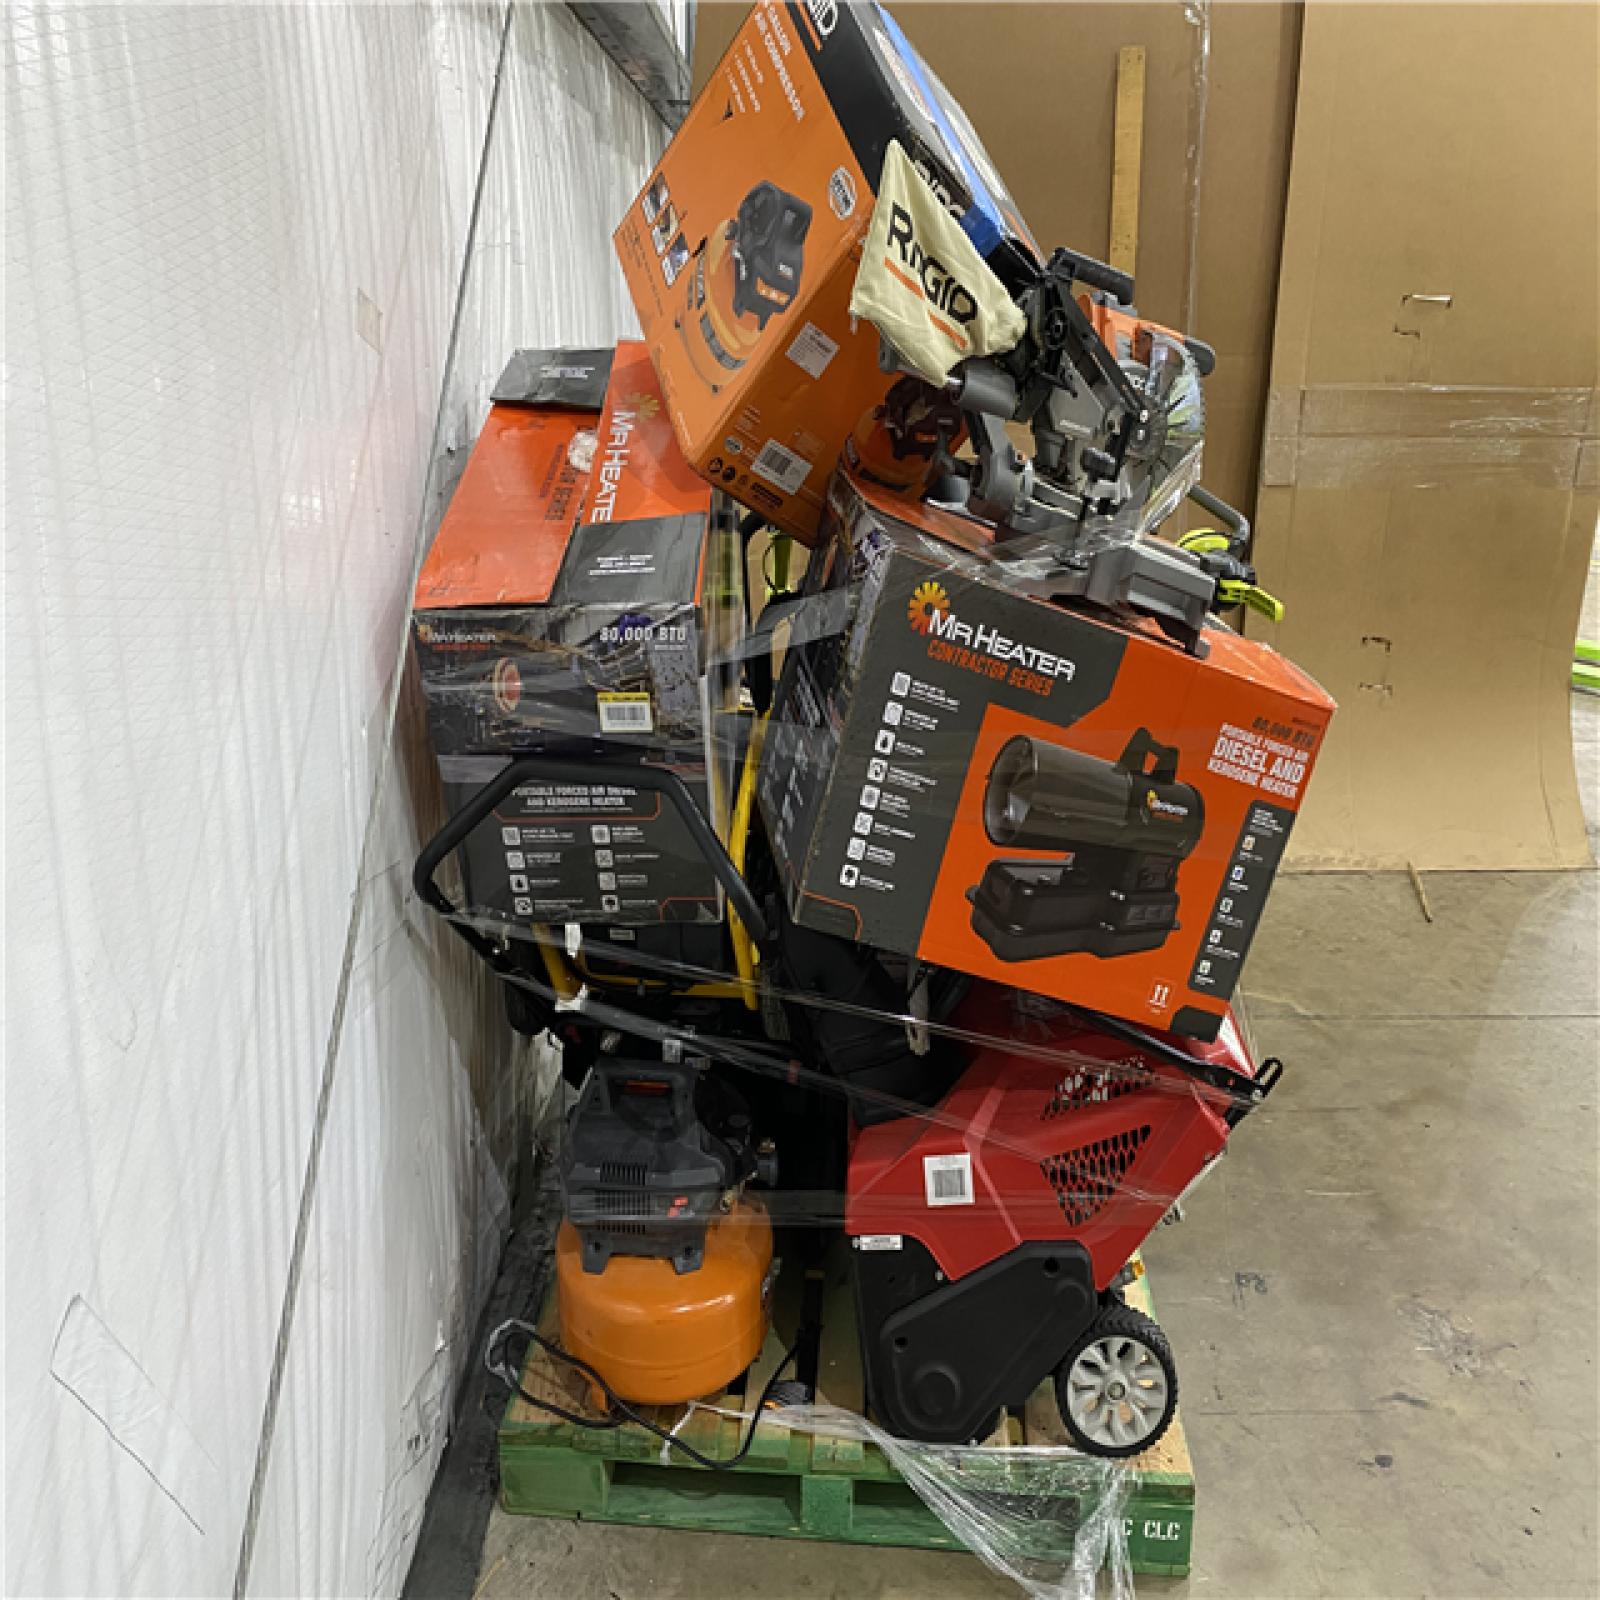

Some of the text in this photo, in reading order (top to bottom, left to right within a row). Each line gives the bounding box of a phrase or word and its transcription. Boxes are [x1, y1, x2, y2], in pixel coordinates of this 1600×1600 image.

[600, 626, 686, 644] 80,000 BTU
[927, 639, 1055, 697] CONTRACTOR SERIES
[1207, 756, 1298, 799] KEROSENE HEATER
[1214, 736, 1305, 783] DIESEL AND
[1144, 1519, 1181, 1541] CLC
